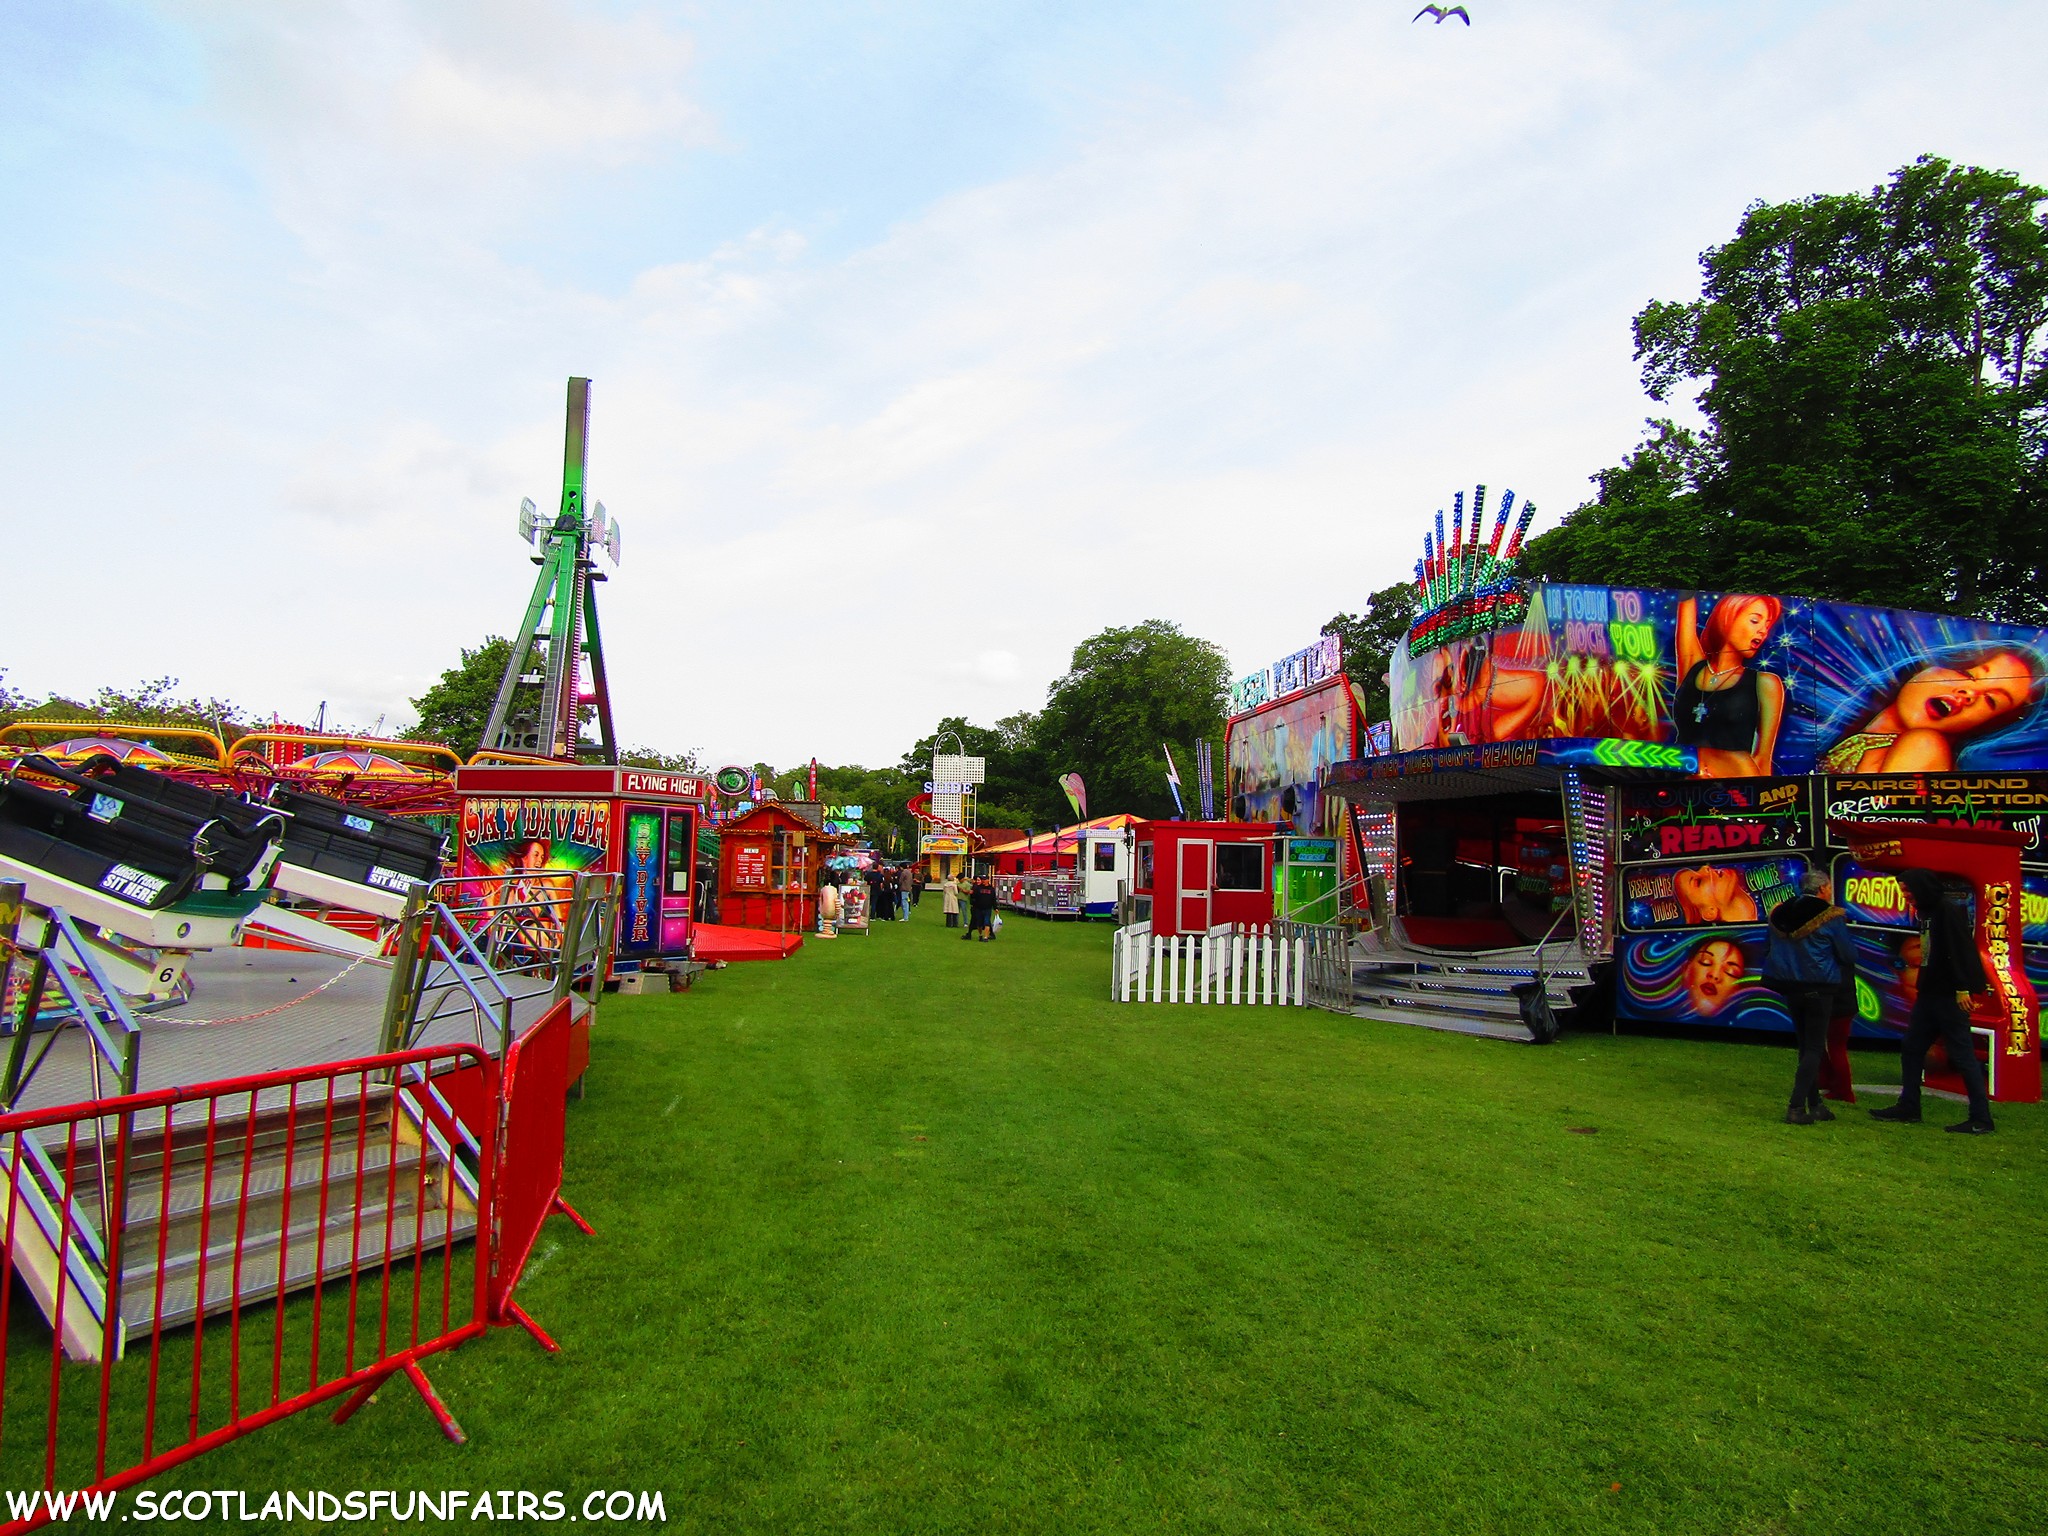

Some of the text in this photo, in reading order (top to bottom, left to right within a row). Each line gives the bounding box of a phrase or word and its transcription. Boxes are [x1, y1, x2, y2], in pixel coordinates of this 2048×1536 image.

[1546, 588, 1641, 623] IN TOWN TO
[1566, 621, 1655, 659] ROCK YOU
[1272, 632, 1342, 698] MOTION
[1403, 752, 1434, 776] RIDES
[1437, 748, 1475, 768] DON'T
[1481, 739, 1538, 769] REACH
[627, 773, 697, 796] FLYING HIGH
[923, 781, 974, 794] SLIDE
[1633, 783, 1799, 807] ROUGH AND
[1835, 778, 2029, 791] FAIRGROUND
[1828, 795, 1890, 818] CREW
[464, 797, 611, 851] SKY DIVER
[1660, 824, 1767, 854] READY
[113, 864, 170, 891] LARGEST PERSON
[369, 873, 411, 893] SIT HER
[373, 865, 398, 880] LARGEST
[632, 823, 651, 943] SKY DIVER
[1745, 862, 1782, 893] COME
[103, 874, 159, 904] SIT HERE
[1628, 875, 1673, 899] FEEL THE
[1845, 875, 1907, 912] PARTY
[1652, 900, 1680, 923] VIBE
[158, 967, 174, 983] 6
